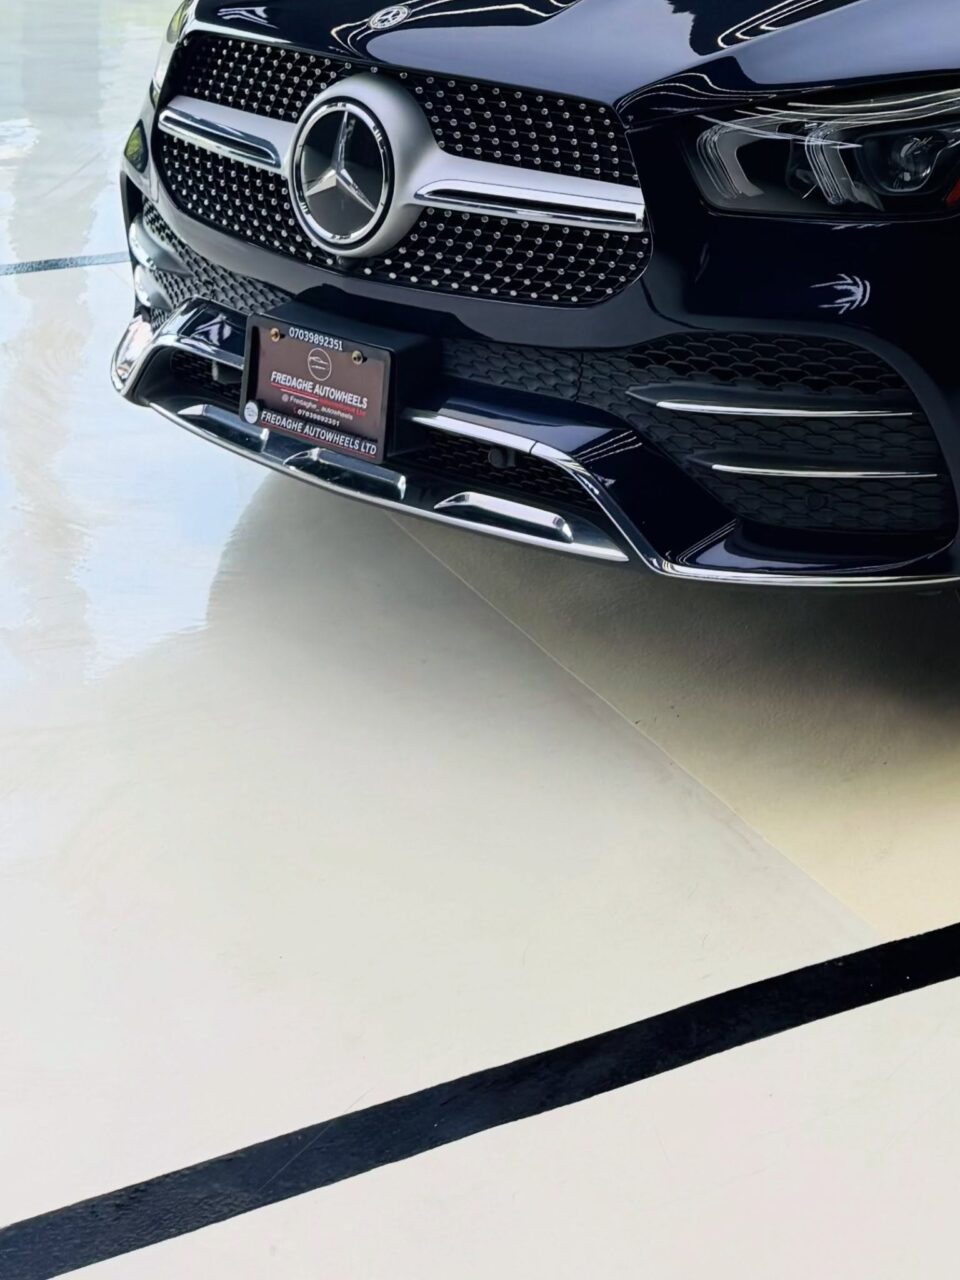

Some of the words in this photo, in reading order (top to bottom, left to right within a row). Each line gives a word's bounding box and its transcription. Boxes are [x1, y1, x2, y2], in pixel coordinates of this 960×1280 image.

[289, 326, 343, 351] 07039892351
[270, 371, 313, 392] FREDAGHE
[313, 384, 368, 408] AUTOWHEELS
[260, 411, 303, 433] FREDAGHE
[303, 425, 360, 450] AUTOWHEELS
[360, 441, 377, 455] LTD
